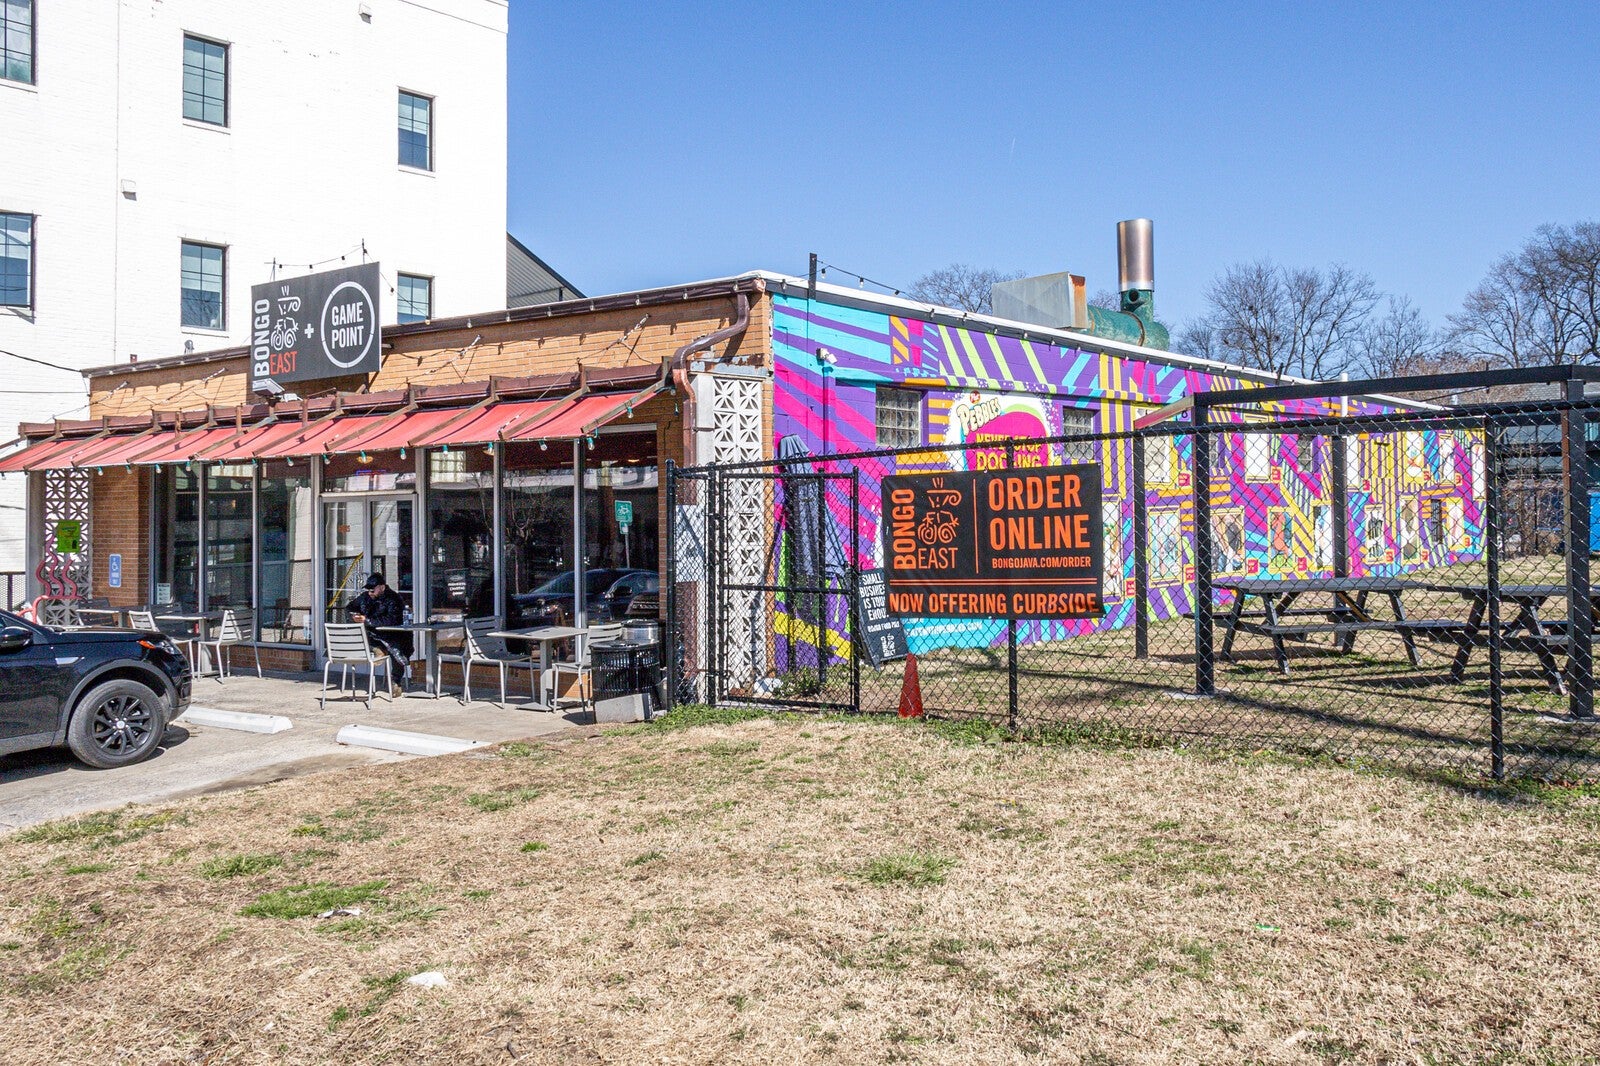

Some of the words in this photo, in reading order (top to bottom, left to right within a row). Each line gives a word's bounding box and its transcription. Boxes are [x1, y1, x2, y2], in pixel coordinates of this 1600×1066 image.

[331, 302, 364, 326] GAME
[254, 299, 270, 377] BONGO
[331, 326, 364, 349] POINT
[269, 351, 298, 375] EAST
[988, 474, 1082, 511] ORDER
[891, 489, 916, 570] BONGO
[989, 514, 1091, 551] ONLINE
[918, 547, 958, 569] EAST
[992, 556, 1091, 569] BONGOJAVA.COM/ORDER
[890, 593, 924, 613] NOW
[928, 593, 1007, 614] OFFERING
[1013, 593, 1099, 614] CURBSIDE
